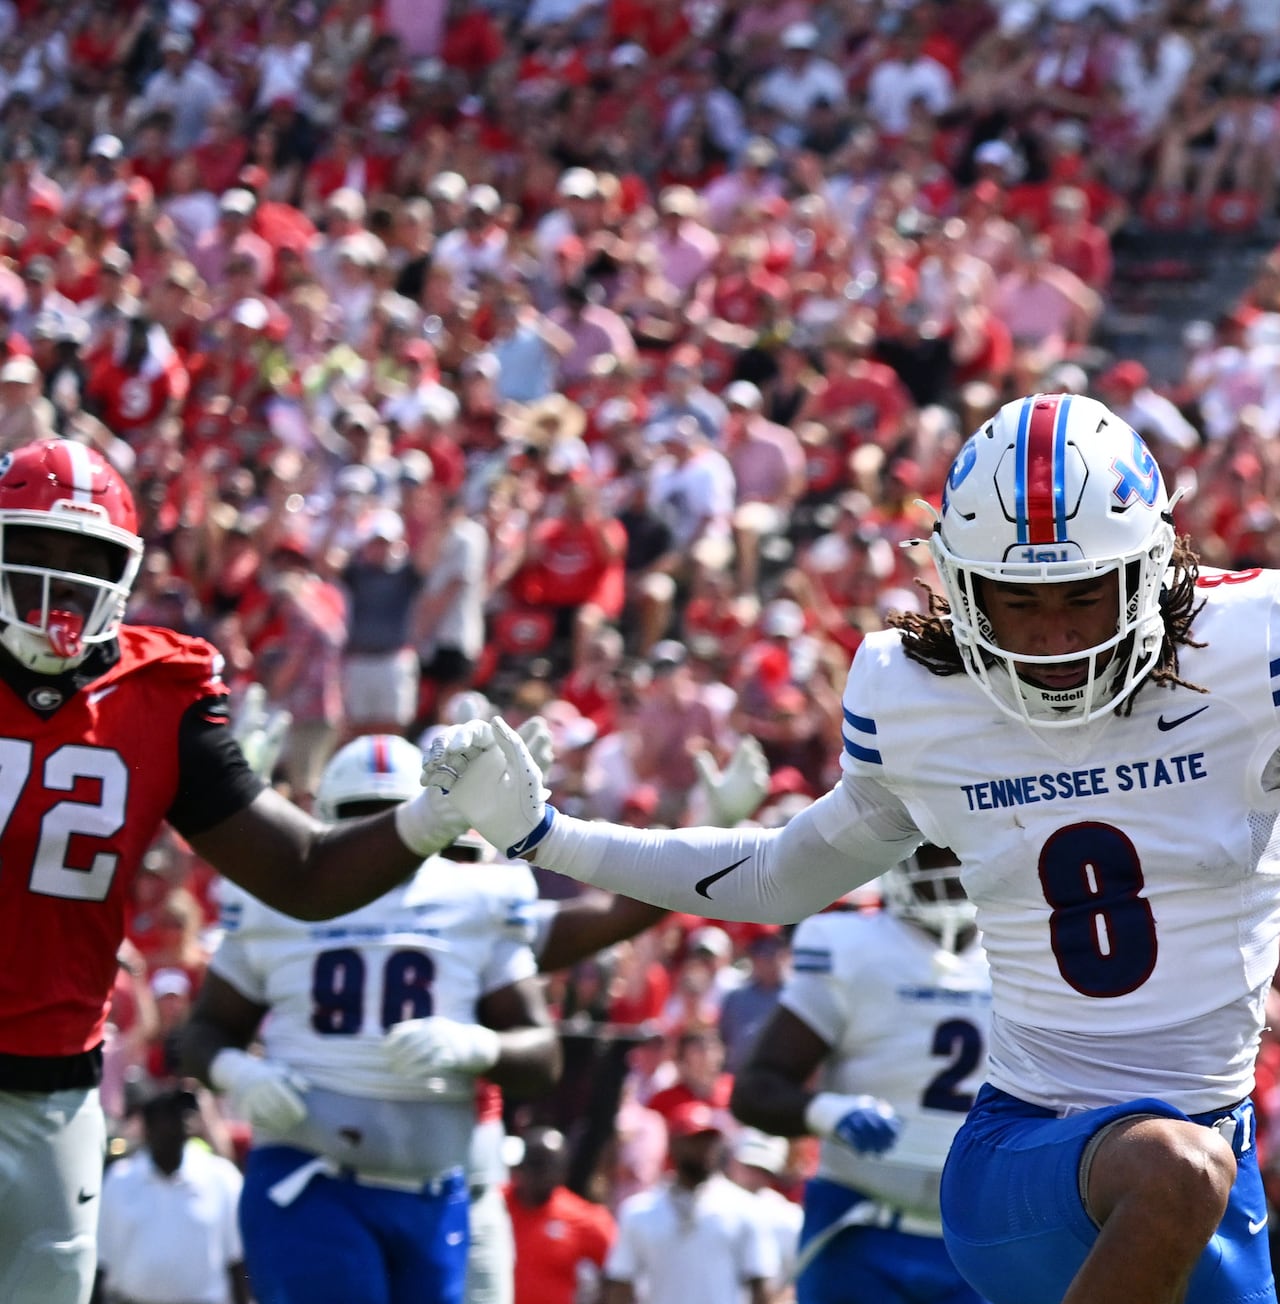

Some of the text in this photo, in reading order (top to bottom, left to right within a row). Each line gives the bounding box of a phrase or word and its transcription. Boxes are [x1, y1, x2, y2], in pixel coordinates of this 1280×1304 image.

[1041, 689, 1084, 703] Riddell
[960, 752, 1207, 811] TENNESSEE STATE
[1038, 820, 1158, 998] 8
[311, 946, 436, 1039] 96
[921, 1016, 984, 1113] 2
